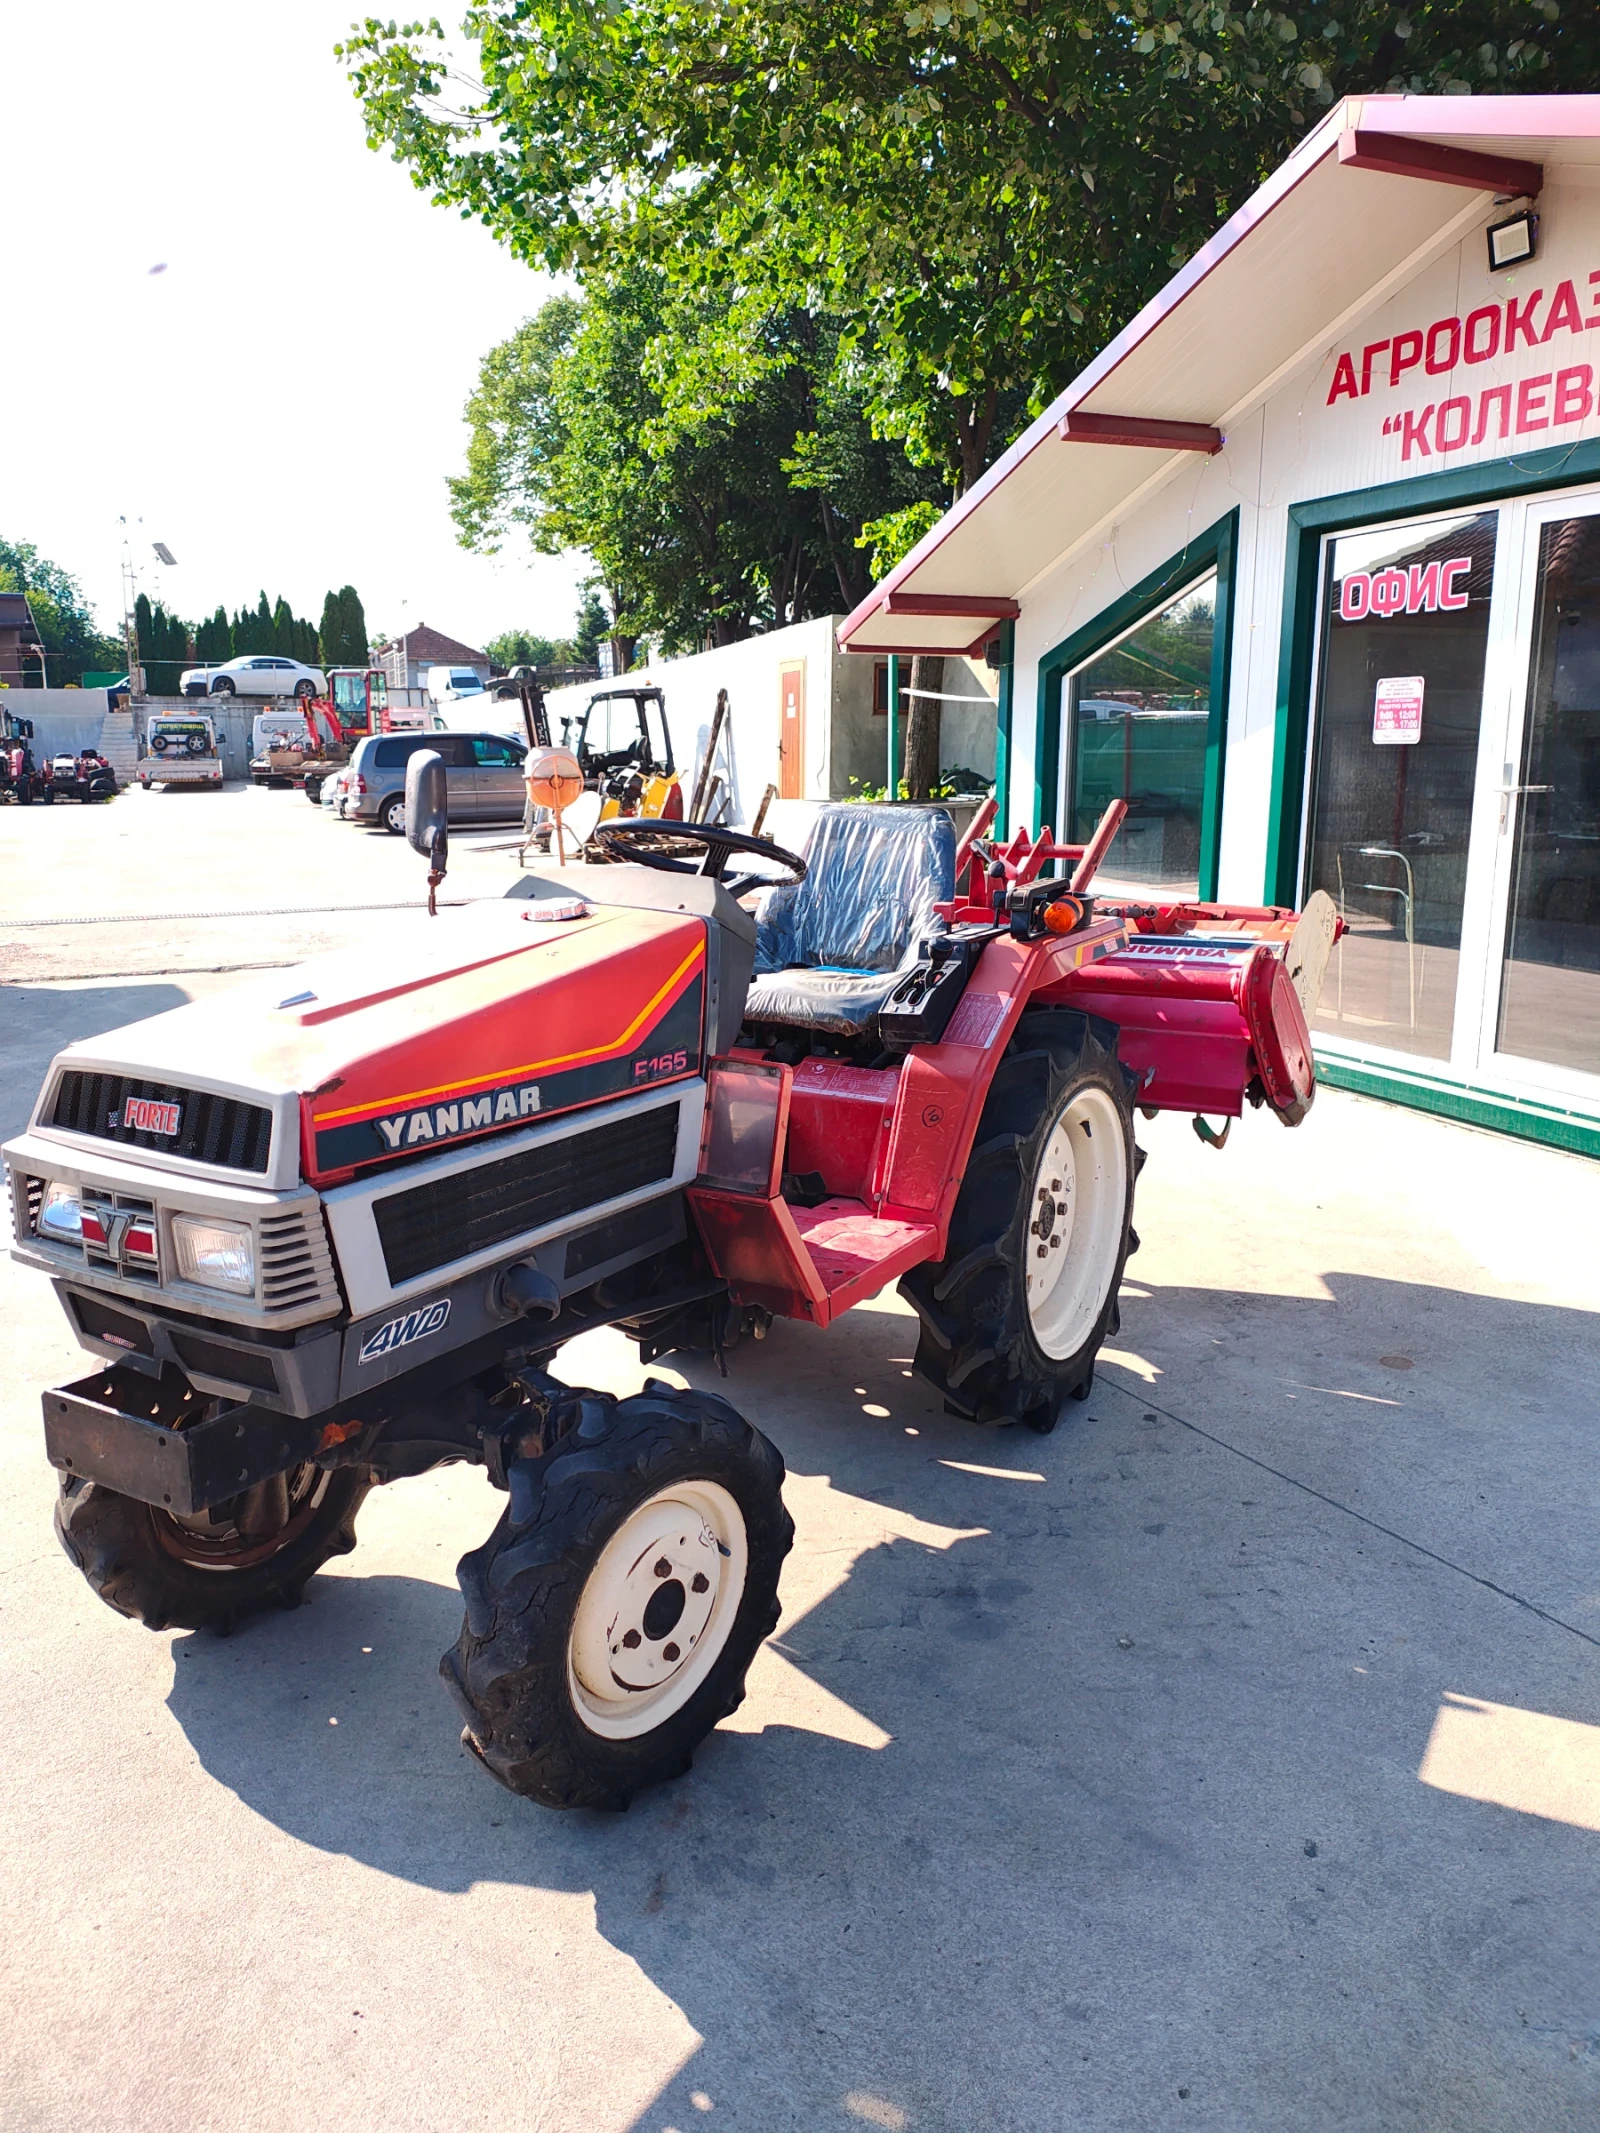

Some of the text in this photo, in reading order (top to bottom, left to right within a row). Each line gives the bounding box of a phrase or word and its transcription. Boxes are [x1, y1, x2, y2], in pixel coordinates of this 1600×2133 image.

[1341, 557, 1472, 621] ОФИС
[634, 1049, 688, 1085] F165
[124, 1097, 180, 1136] FORTE
[379, 1085, 541, 1148] YANMAR
[359, 1298, 452, 1363] 4WD
